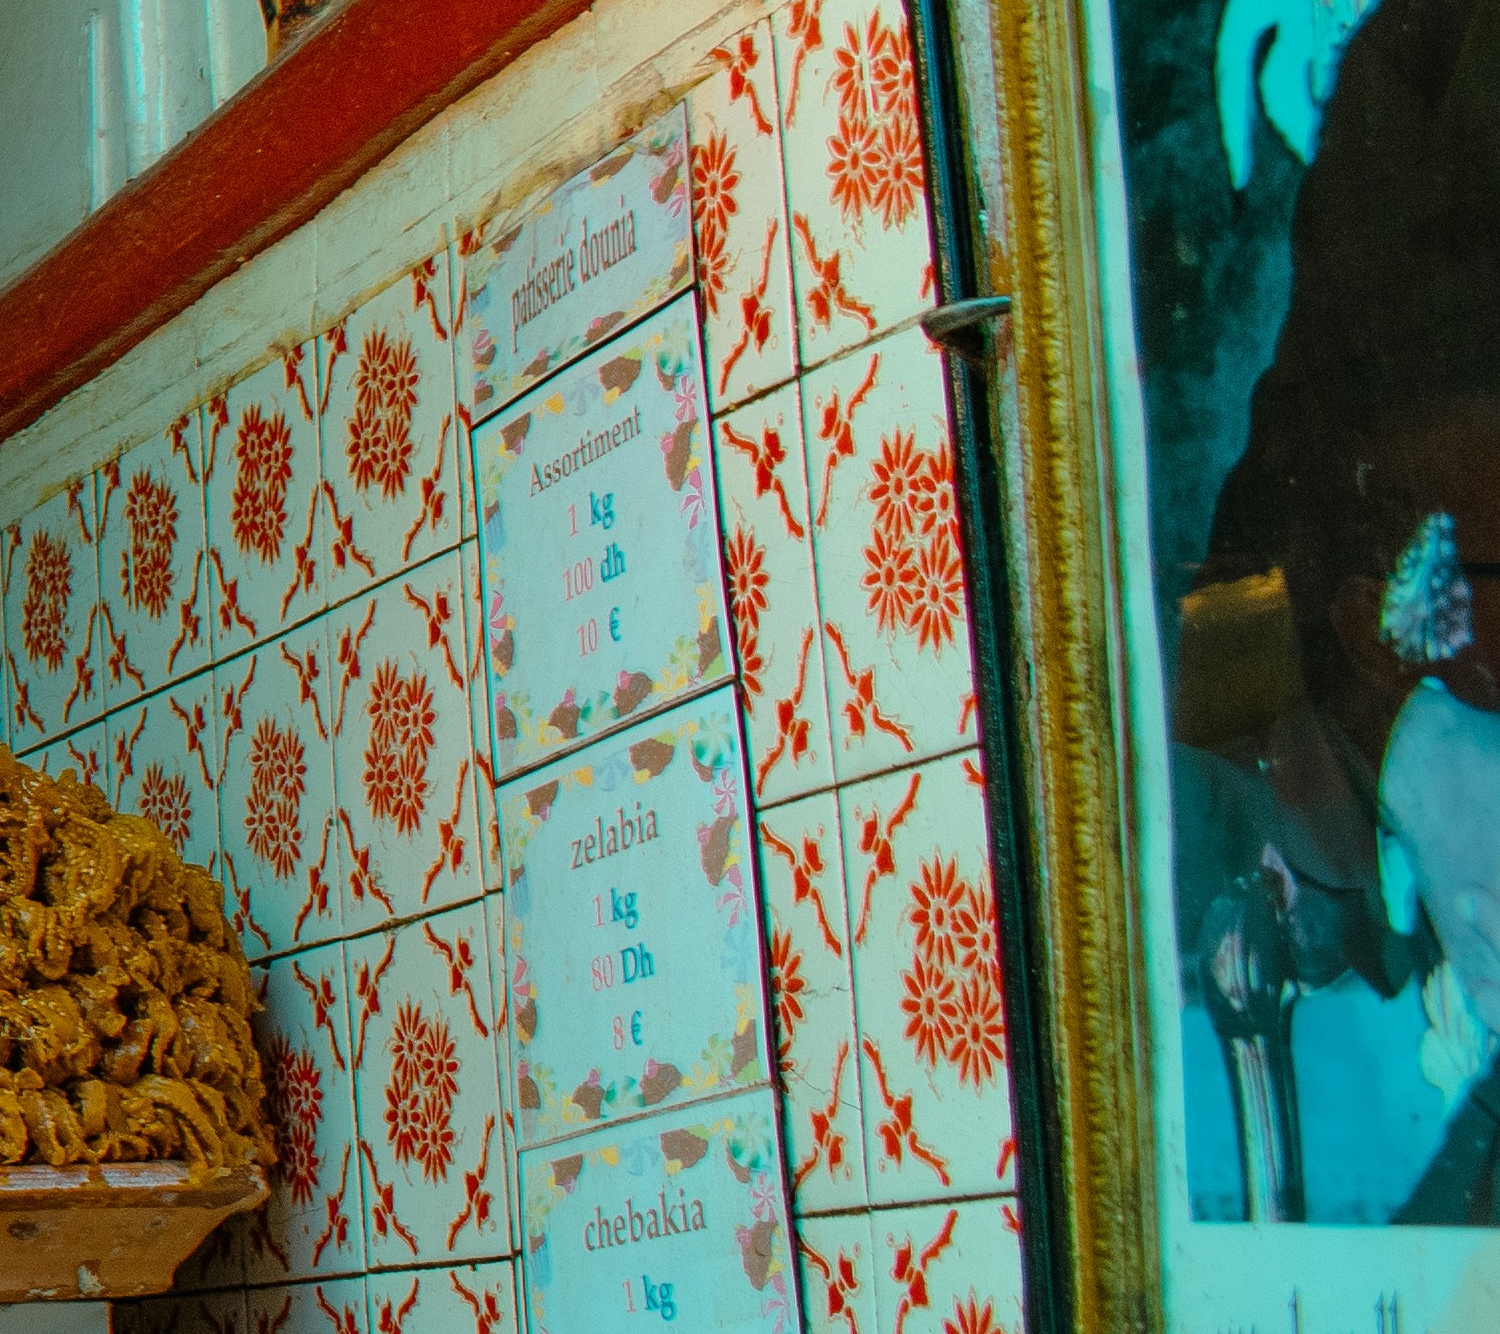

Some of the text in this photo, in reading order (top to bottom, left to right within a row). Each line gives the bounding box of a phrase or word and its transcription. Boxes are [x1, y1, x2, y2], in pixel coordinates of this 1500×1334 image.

[510, 193, 637, 355] patisserie dounia
[528, 404, 642, 498] Assortiment
[568, 490, 616, 537] 1 kg
[562, 542, 627, 602] 100 dh
[577, 605, 622, 657] 10 €
[569, 800, 660, 871] zelabia
[592, 886, 639, 930] 1 kg
[591, 942, 657, 993] 80 Dh
[612, 1009, 644, 1052] 8 €
[583, 1186, 708, 1251] chebakia
[622, 1273, 678, 1322] 1 kg
